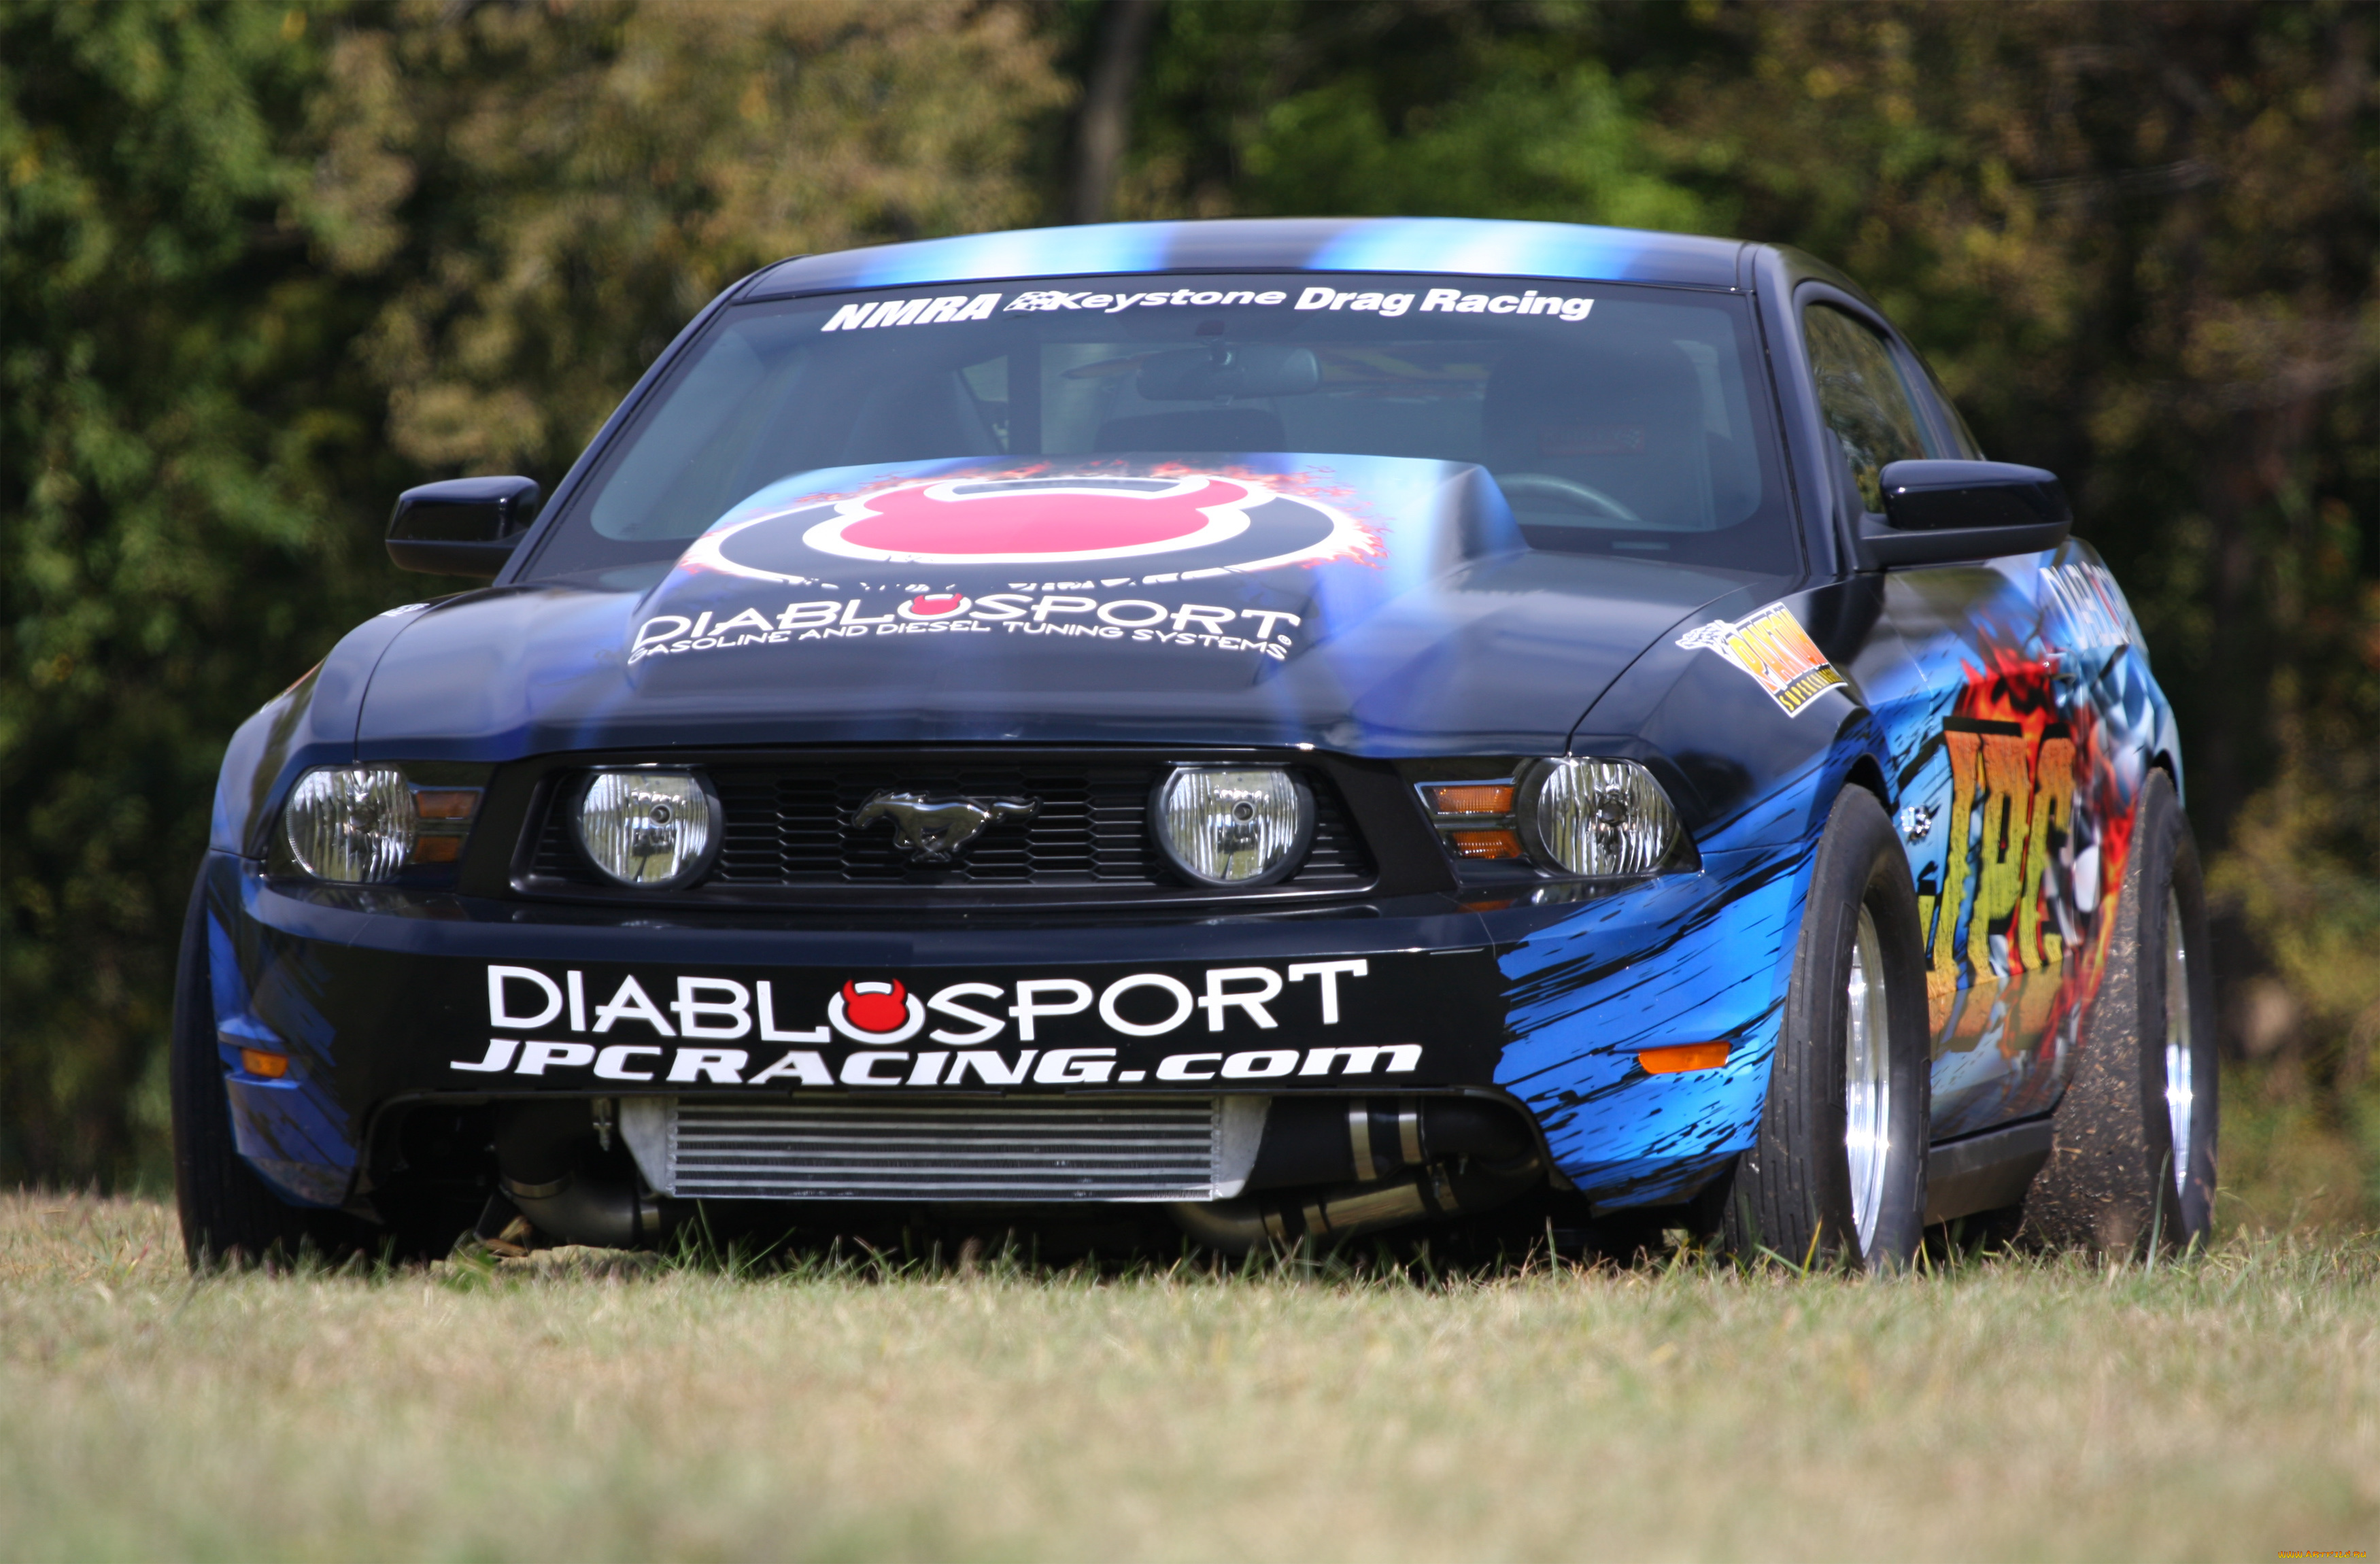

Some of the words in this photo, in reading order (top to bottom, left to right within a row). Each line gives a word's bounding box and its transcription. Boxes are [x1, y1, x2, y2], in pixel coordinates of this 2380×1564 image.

[821, 293, 1002, 332] NMRA
[1044, 289, 1287, 313] Keystone
[1294, 287, 1416, 317] Drag
[1419, 288, 1595, 321] Racing
[627, 630, 792, 665] GASOLINE
[798, 625, 869, 640] AND
[875, 619, 991, 636] DIESEL
[1002, 621, 1124, 639] TUNING
[1132, 628, 1287, 661] SYSTEMS
[488, 959, 1367, 1044] DIABLOSPORT
[451, 1036, 1422, 1085] JPCRACING.com
